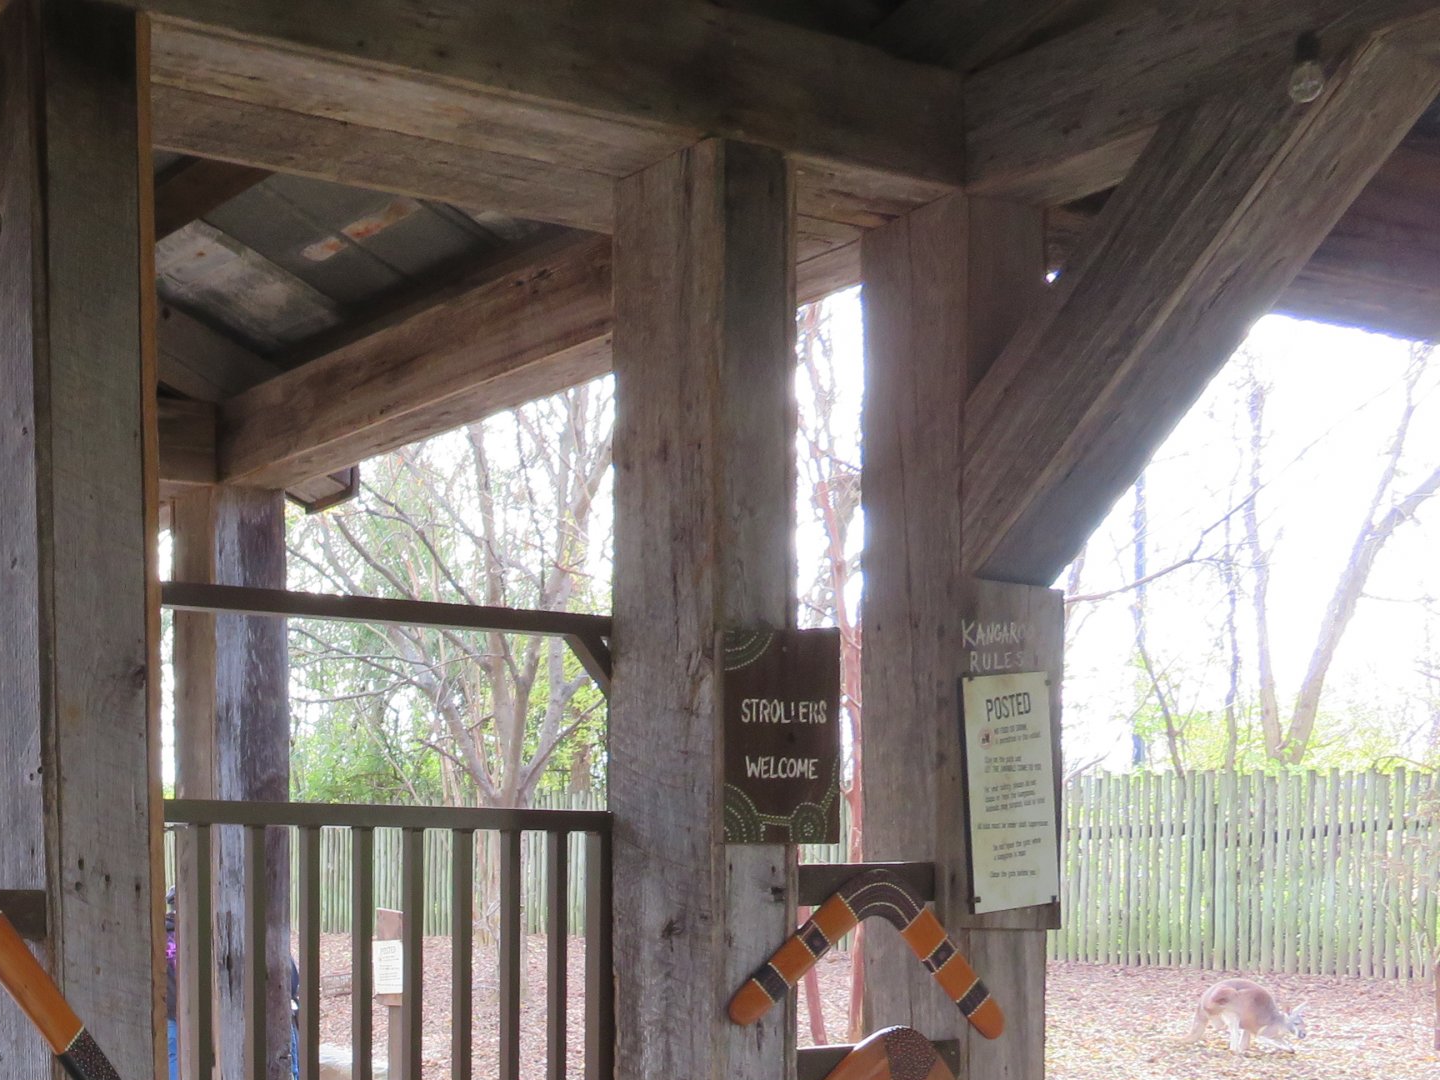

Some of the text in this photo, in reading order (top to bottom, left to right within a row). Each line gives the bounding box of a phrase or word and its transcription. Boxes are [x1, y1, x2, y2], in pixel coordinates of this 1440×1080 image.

[969, 651, 1024, 672] RULES
[985, 691, 1031, 722] POSTED
[745, 756, 819, 779] WELCOME
